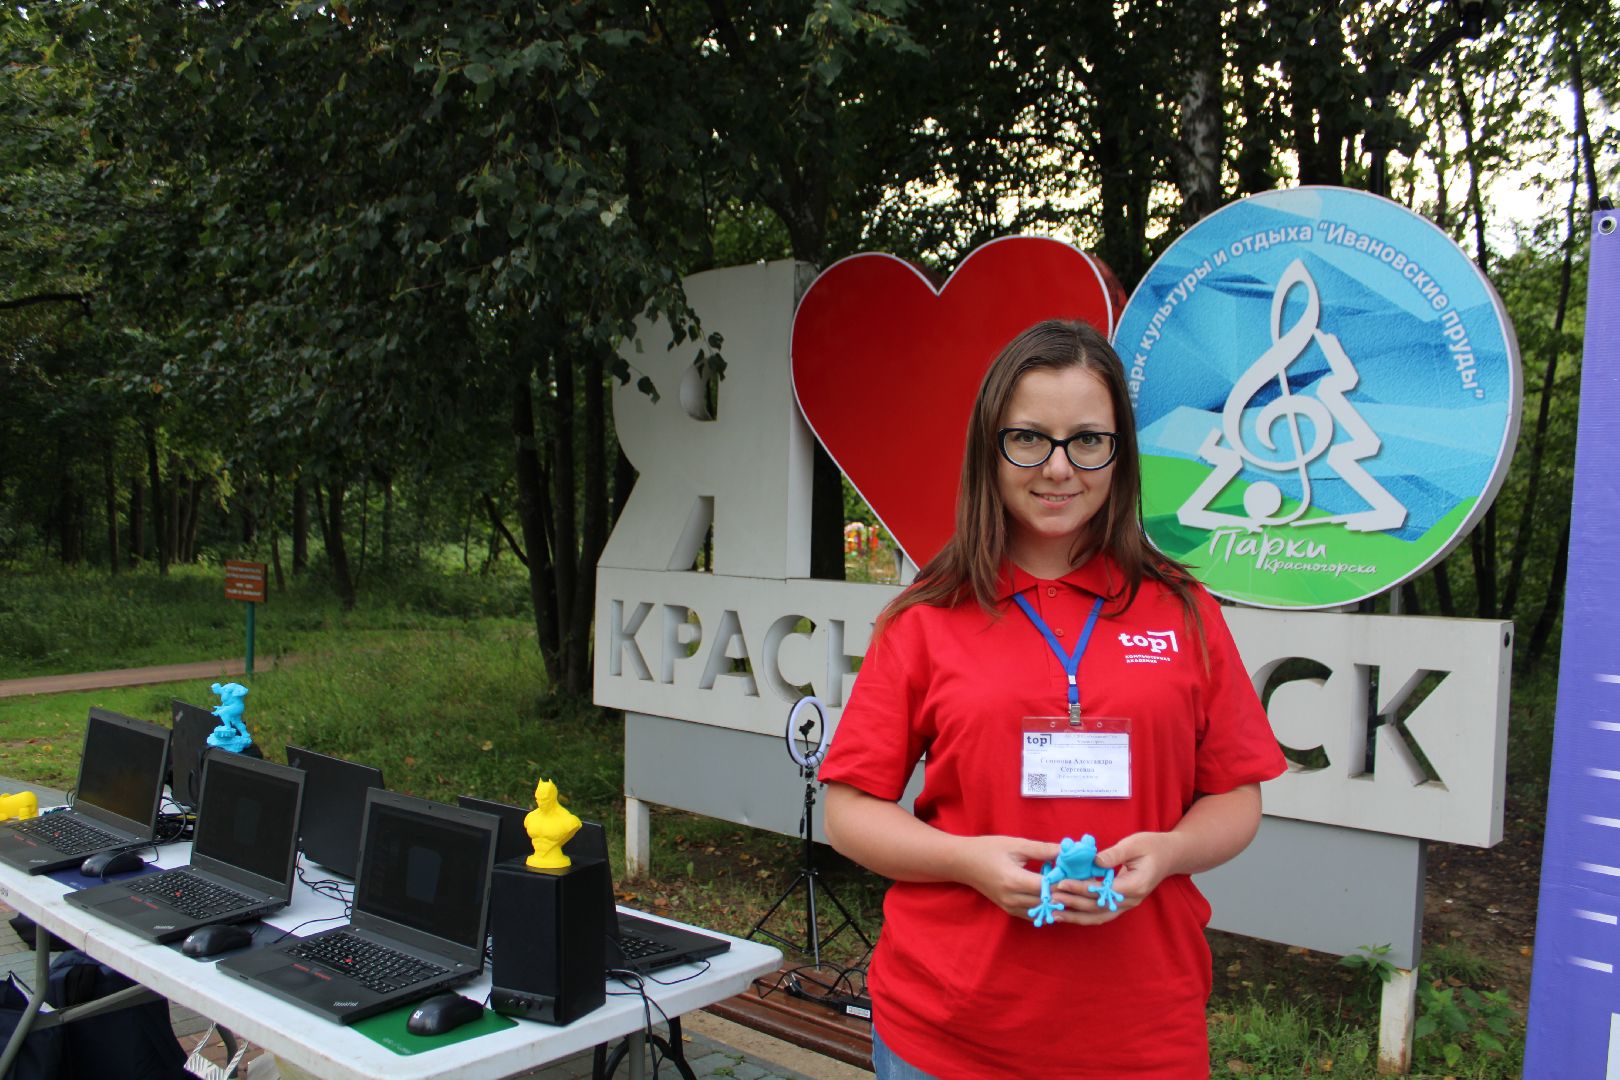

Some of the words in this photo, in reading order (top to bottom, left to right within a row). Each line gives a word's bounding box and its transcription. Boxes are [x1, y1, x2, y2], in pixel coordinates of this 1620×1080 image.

[1140, 261, 1213, 350] культуры
[1213, 250, 1228, 267] и
[1231, 225, 1313, 257] отдыха
[596, 258, 814, 579] Я
[1209, 529, 1327, 569] Парки
[1264, 558, 1377, 577] Красногорска
[1118, 632, 1168, 654] top
[1026, 735, 1048, 747] top
